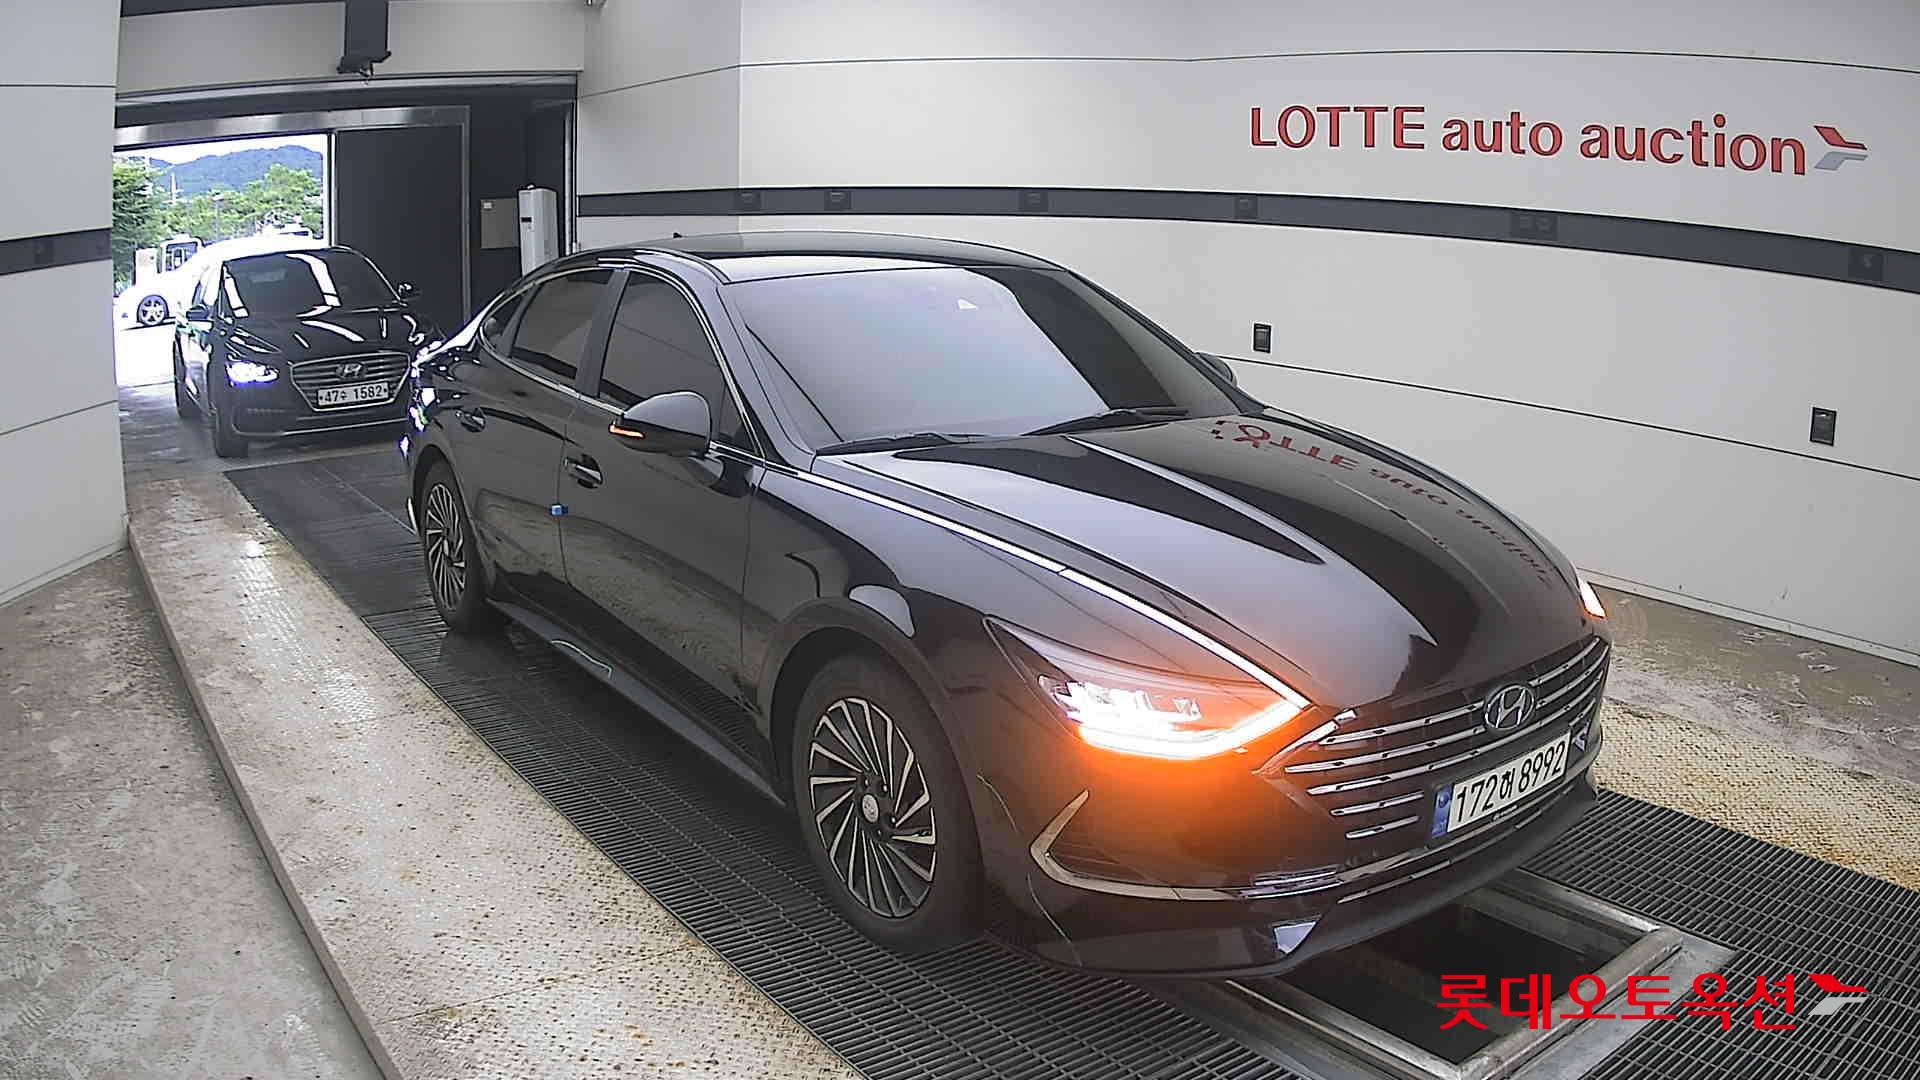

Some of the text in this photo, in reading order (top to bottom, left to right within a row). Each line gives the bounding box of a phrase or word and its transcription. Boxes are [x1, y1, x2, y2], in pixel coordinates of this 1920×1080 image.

[1251, 105, 1807, 177] LOTTE auto auction
[353, 385, 383, 400] 1582
[1518, 741, 1566, 793] 8992
